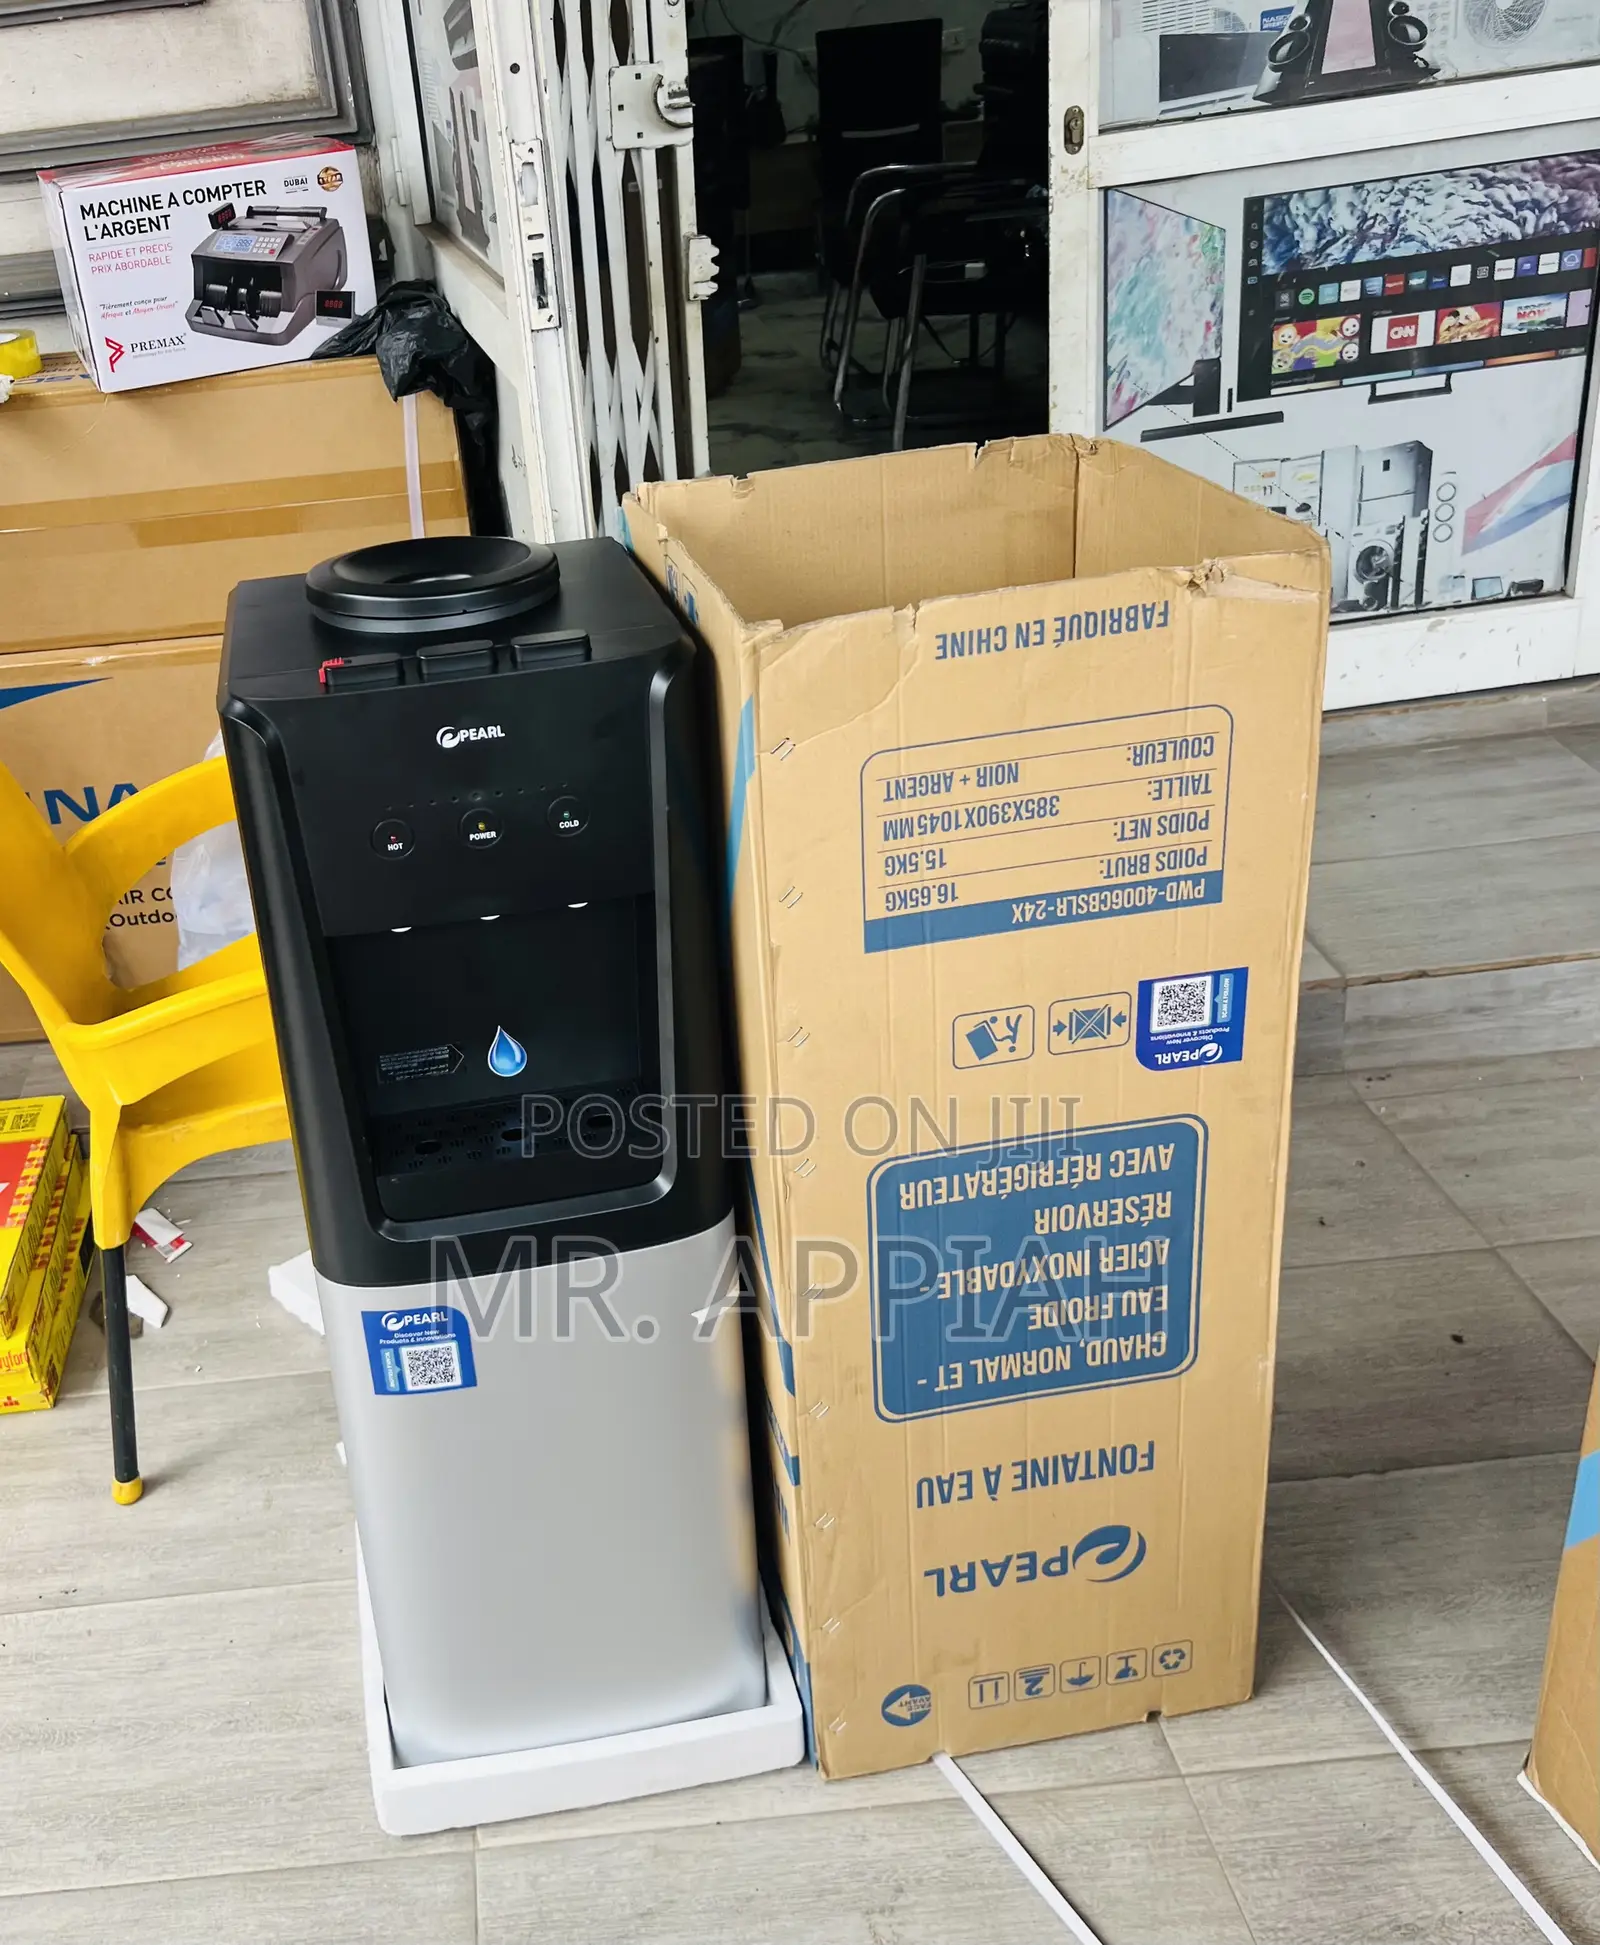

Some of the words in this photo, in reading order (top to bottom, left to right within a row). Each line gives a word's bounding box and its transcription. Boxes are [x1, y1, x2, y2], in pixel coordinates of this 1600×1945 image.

[284, 177, 308, 187] DUBAI
[80, 194, 164, 220] MACHINE
[168, 192, 180, 208] A
[182, 180, 267, 206] COMPTER
[84, 214, 171, 241] L'ARGENT
[88, 249, 123, 262] RAPIDE
[126, 247, 136, 258] ET
[91, 263, 113, 275] PRIX
[114, 256, 172, 272] ABORDABLE
[1389, 325, 1416, 339] CNN
[1015, 619, 1045, 648] EN
[1052, 600, 1170, 648] FABRIQUÉ
[935, 625, 1008, 660] CHINE
[460, 725, 505, 741] PEARL
[1126, 735, 1214, 767] COULEUR:
[883, 771, 954, 802] ARGENT
[960, 774, 970, 785] +
[976, 762, 1019, 788] NOIR
[1148, 773, 1212, 801] TAILLE:
[559, 820, 579, 829] COLD
[917, 795, 1060, 836] 385X390X1045
[1113, 817, 1152, 842] NET:
[1157, 809, 1210, 836] POIDS
[469, 831, 497, 841] POWER
[883, 820, 914, 842] MM
[388, 843, 403, 851] HOT
[1155, 846, 1208, 871] POIDS
[884, 848, 947, 876] 15.5KG
[1100, 853, 1150, 879] BRUT:
[119, 889, 145, 905] IR
[885, 881, 958, 912] 16.65KG
[1011, 878, 1205, 924] PWD-4006CBSLR-24X
[1150, 1033, 1191, 1041] Innovations
[1182, 1035, 1213, 1043] Discover
[1155, 1049, 1200, 1065] PEARL
[1109, 1143, 1175, 1178] AVEC
[900, 1152, 1102, 1210] RÉFRIGÉRATEUR
[1034, 1191, 1172, 1235] RÉSERVOIR
[1099, 1238, 1170, 1273] ACIER
[937, 1249, 1090, 1299] INOXYDABLE
[1028, 1294, 1113, 1330] FROIDE
[1121, 1285, 1168, 1317] EAU
[404, 1311, 449, 1326] PEARL
[394, 1331, 423, 1339] Discover
[1079, 1331, 1166, 1367] CHAUD,
[934, 1362, 963, 1392] ET
[970, 1345, 1071, 1384] NORMAL
[1011, 1440, 1155, 1492] FONTAINE
[916, 1469, 974, 1508] EAU
[983, 1464, 1002, 1501] À
[924, 1545, 1069, 1598] PEARL
